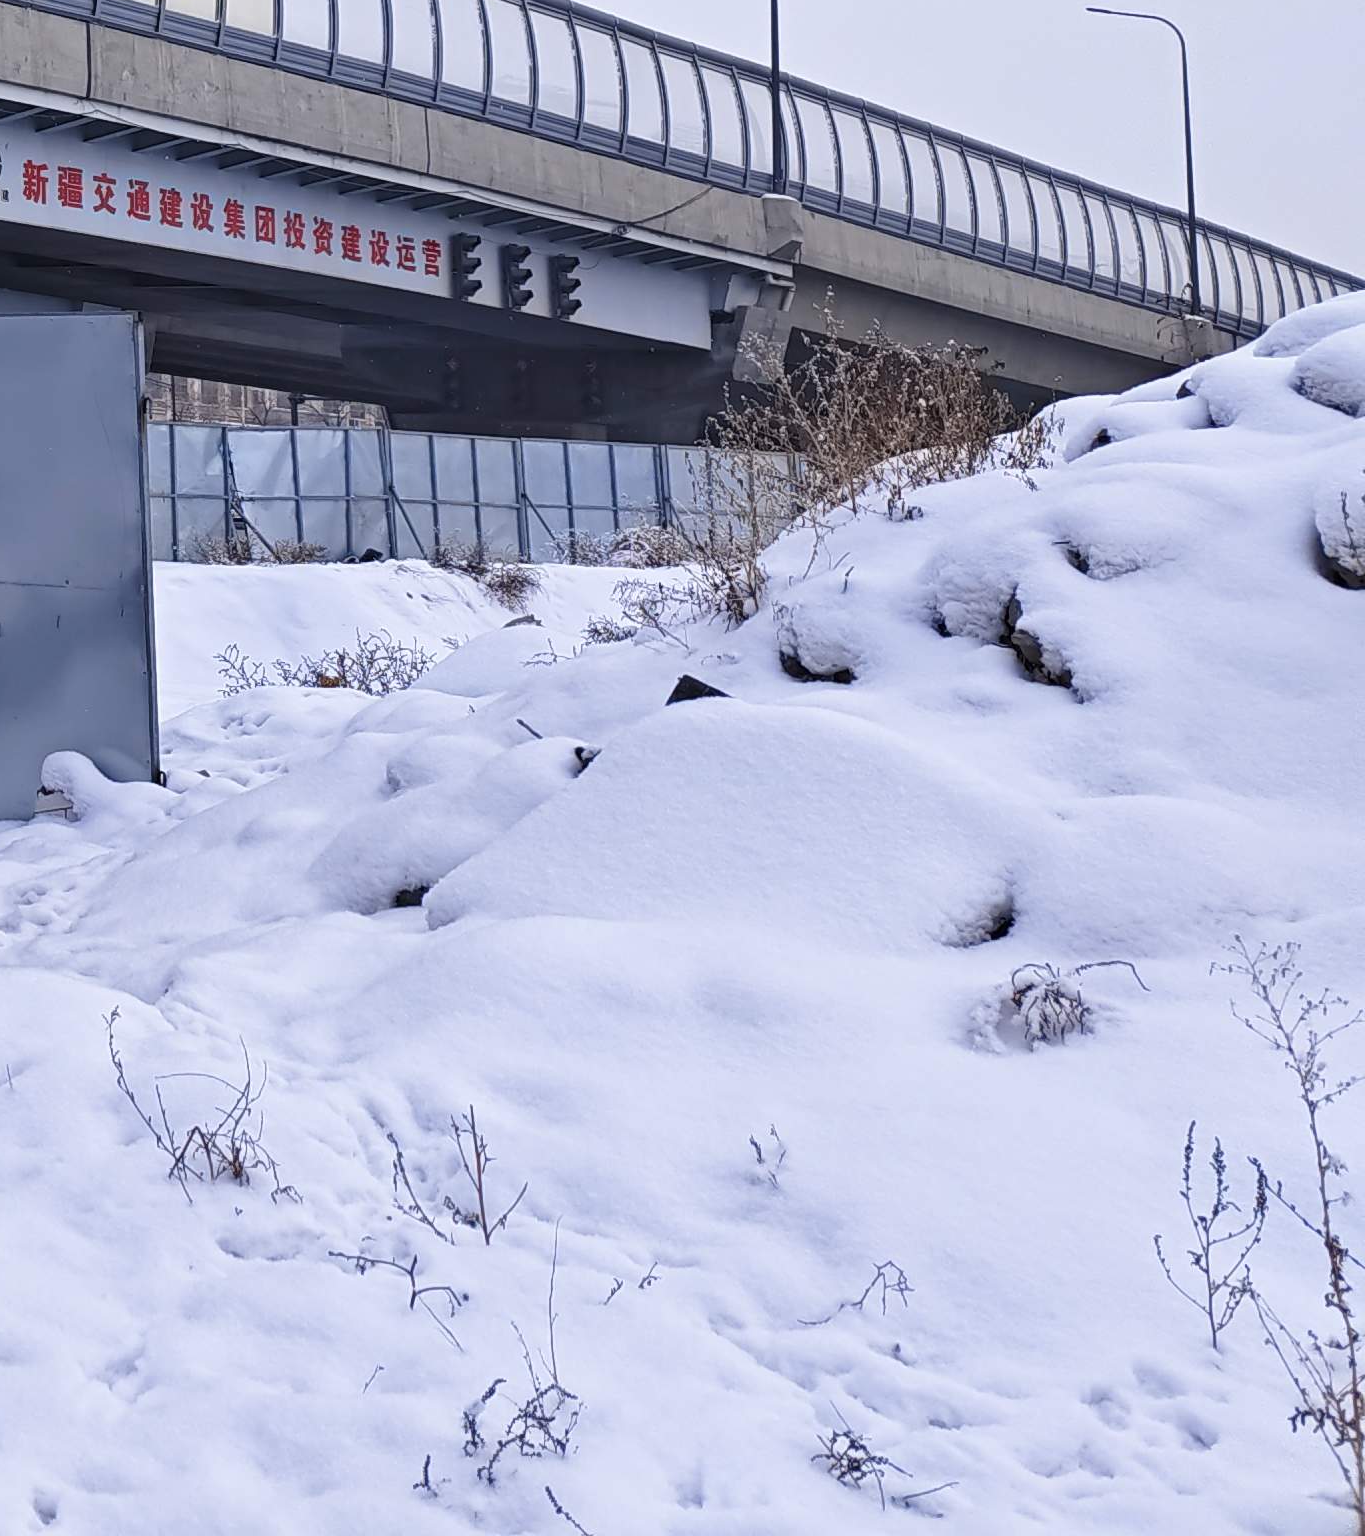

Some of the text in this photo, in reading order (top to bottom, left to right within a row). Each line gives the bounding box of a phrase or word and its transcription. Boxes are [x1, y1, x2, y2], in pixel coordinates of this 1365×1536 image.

[22, 159, 442, 278] 新疆交通建设集团投资建设运营
